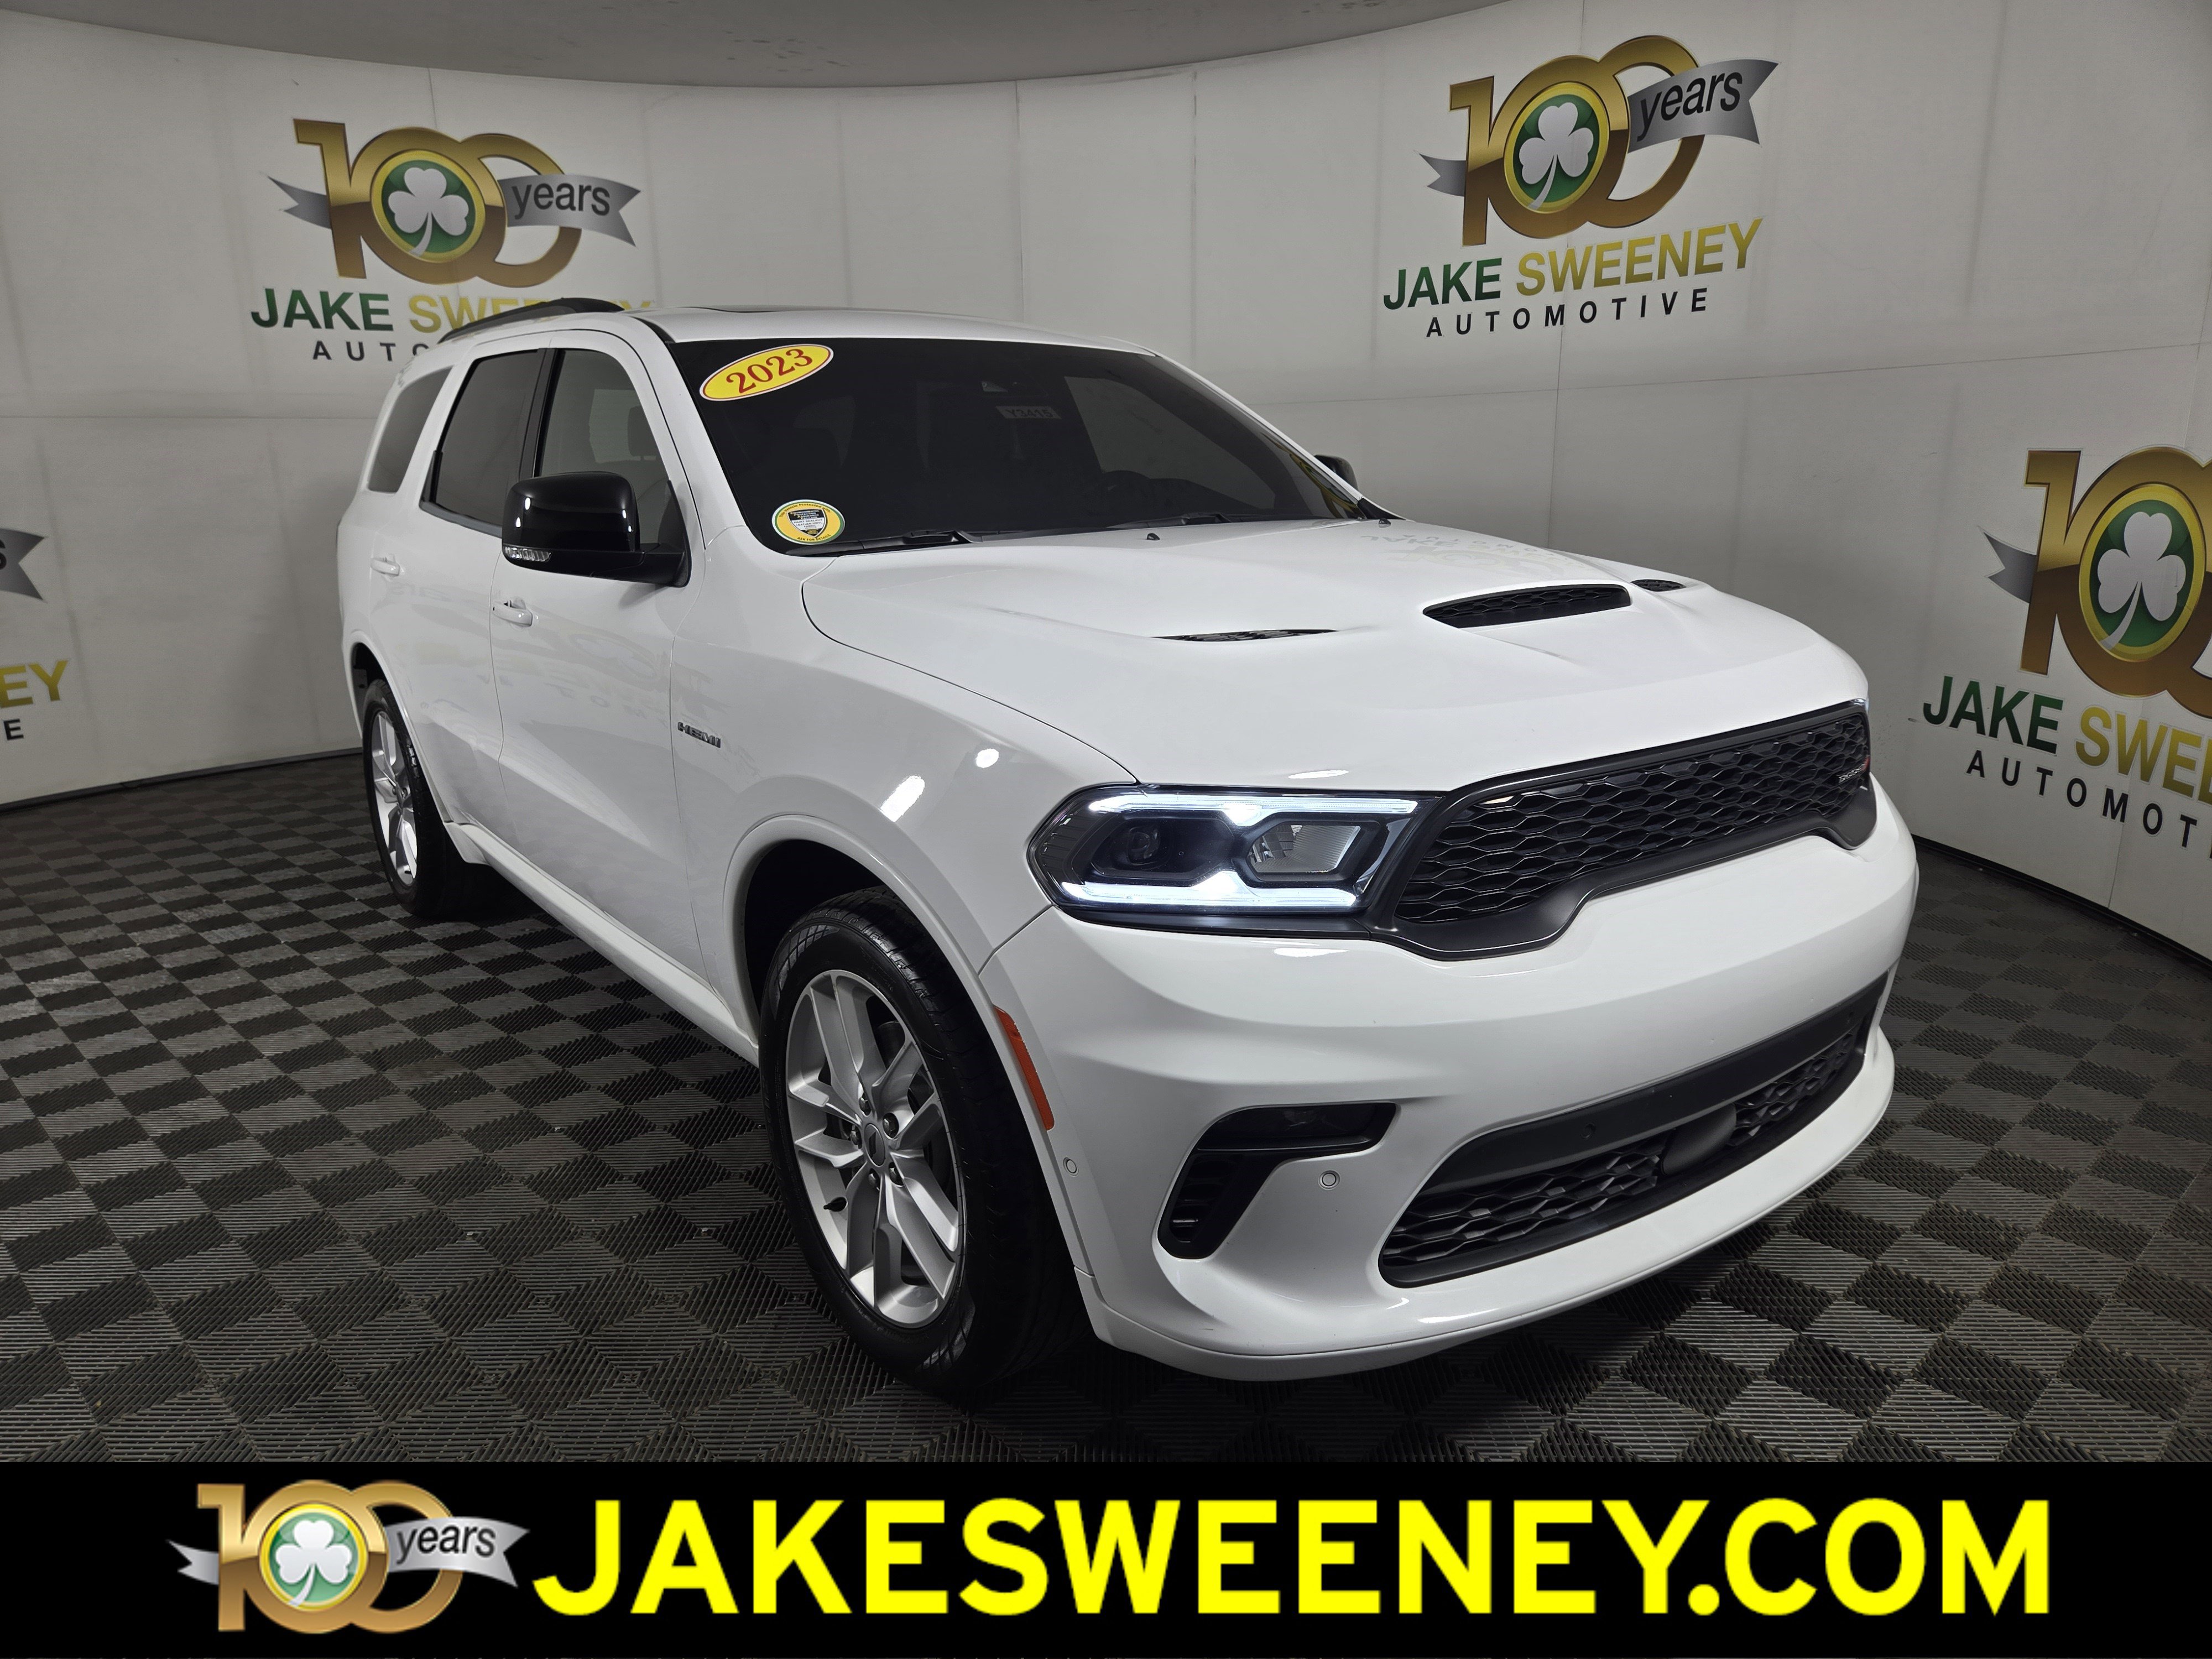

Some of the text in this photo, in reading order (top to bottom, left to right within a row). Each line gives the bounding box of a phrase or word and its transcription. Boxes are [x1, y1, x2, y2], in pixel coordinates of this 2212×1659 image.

[1449, 35, 1743, 247] 100 years
[294, 118, 612, 288] 100 years
[1384, 218, 1764, 310] JAKE SWEENEY
[251, 288, 394, 331] JAKE
[1426, 287, 1708, 338] AUTOMOTIVE
[726, 348, 813, 394] 2023
[677, 722, 721, 748] HEMI
[1923, 676, 2063, 754] JAKE
